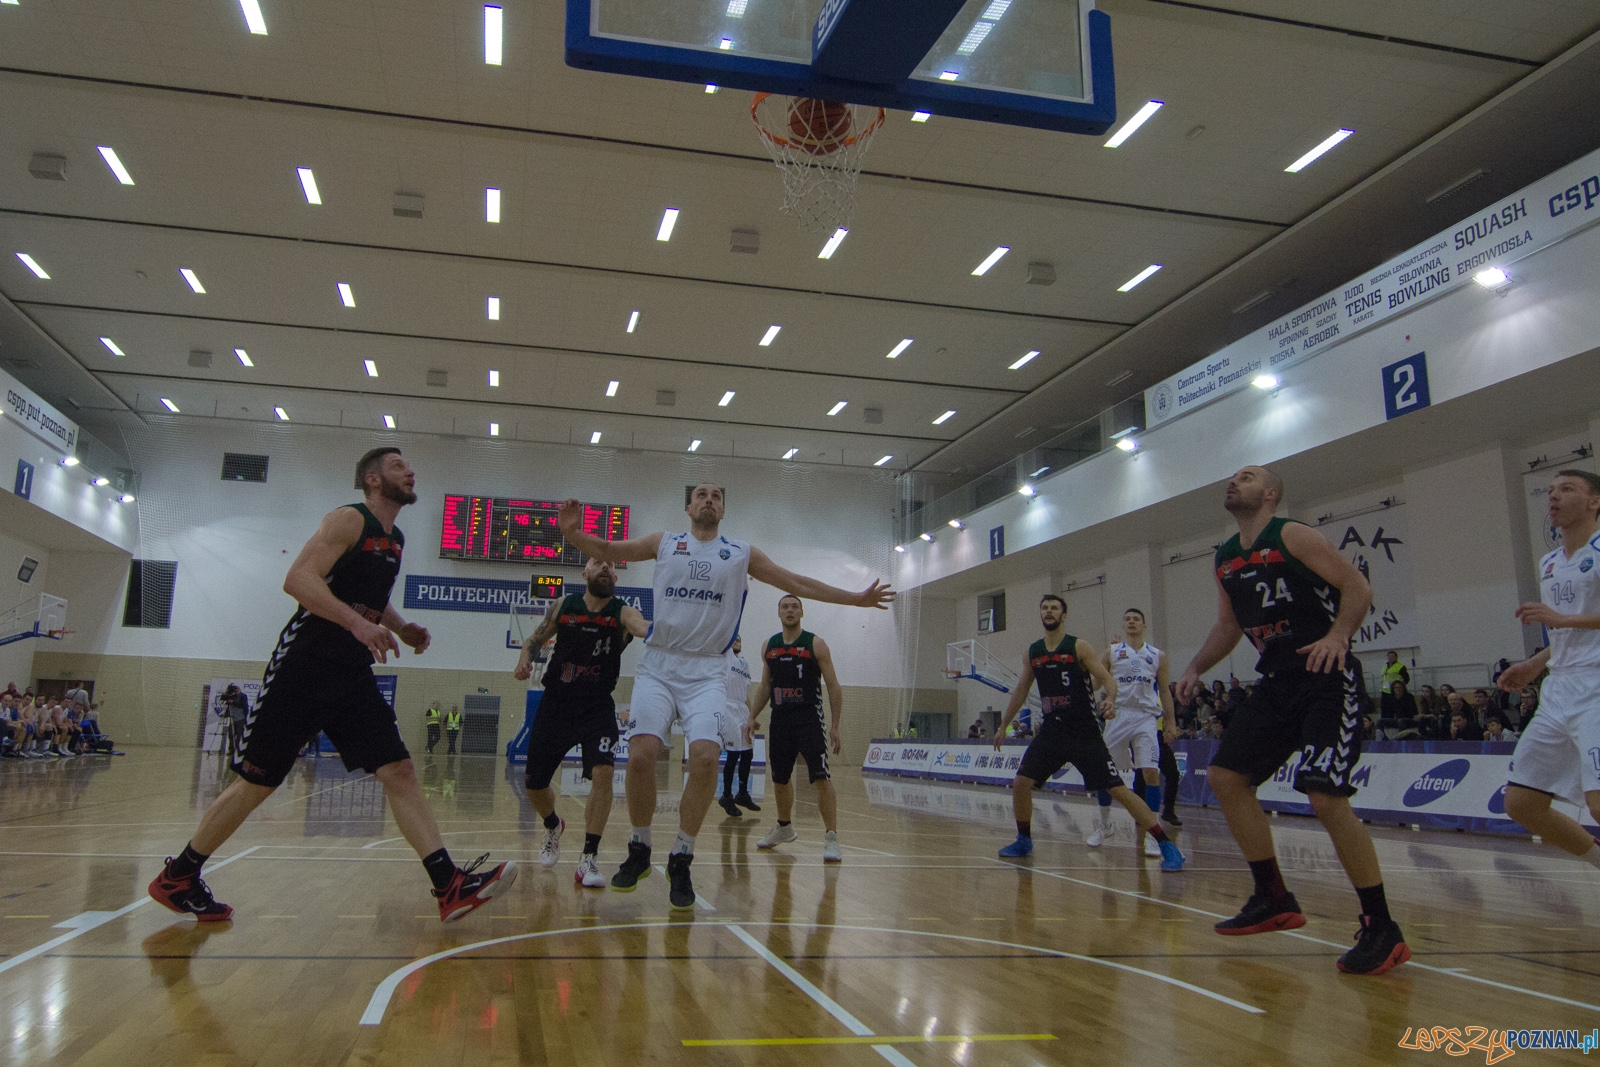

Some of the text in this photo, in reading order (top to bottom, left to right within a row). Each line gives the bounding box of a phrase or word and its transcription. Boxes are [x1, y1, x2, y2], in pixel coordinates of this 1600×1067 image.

[1454, 198, 1528, 251] SQUASH
[1456, 229, 1534, 276] ERGOWIOSŁA
[1398, 256, 1442, 286] SIŁOWNIA
[1343, 283, 1365, 302] JUDO
[1387, 266, 1451, 310] BOWLING
[1345, 288, 1383, 318] TENIS
[1268, 296, 1338, 341] HALA SPORTOWA
[1315, 312, 1338, 329] SZACHY
[1352, 310, 1375, 326] KARATE
[1302, 323, 1341, 351] AEROBIK
[1269, 346, 1296, 366] BOISKA
[1177, 358, 1231, 391] Centrum Sportu
[1178, 357, 1263, 407] Politechniki Poznańskiej
[1393, 363, 1417, 410] 2
[7, 389, 75, 447] cspp.put.poznan.pl
[21, 466, 29, 495] 1
[513, 513, 530, 525] 46
[993, 530, 1000, 556] 1
[688, 560, 712, 582] 12
[548, 586, 556, 597] 7
[665, 587, 723, 603] BIOFARM
[1255, 577, 1294, 609] 24
[1551, 580, 1575, 606] 14
[592, 636, 611, 657] 84
[796, 663, 804, 679] 1
[1061, 671, 1071, 687] 5
[1131, 659, 1142, 673] 2
[598, 736, 619, 759] 84
[1300, 744, 1334, 773] 24
[1107, 761, 1118, 777] 5
[1413, 774, 1455, 792] atrem
